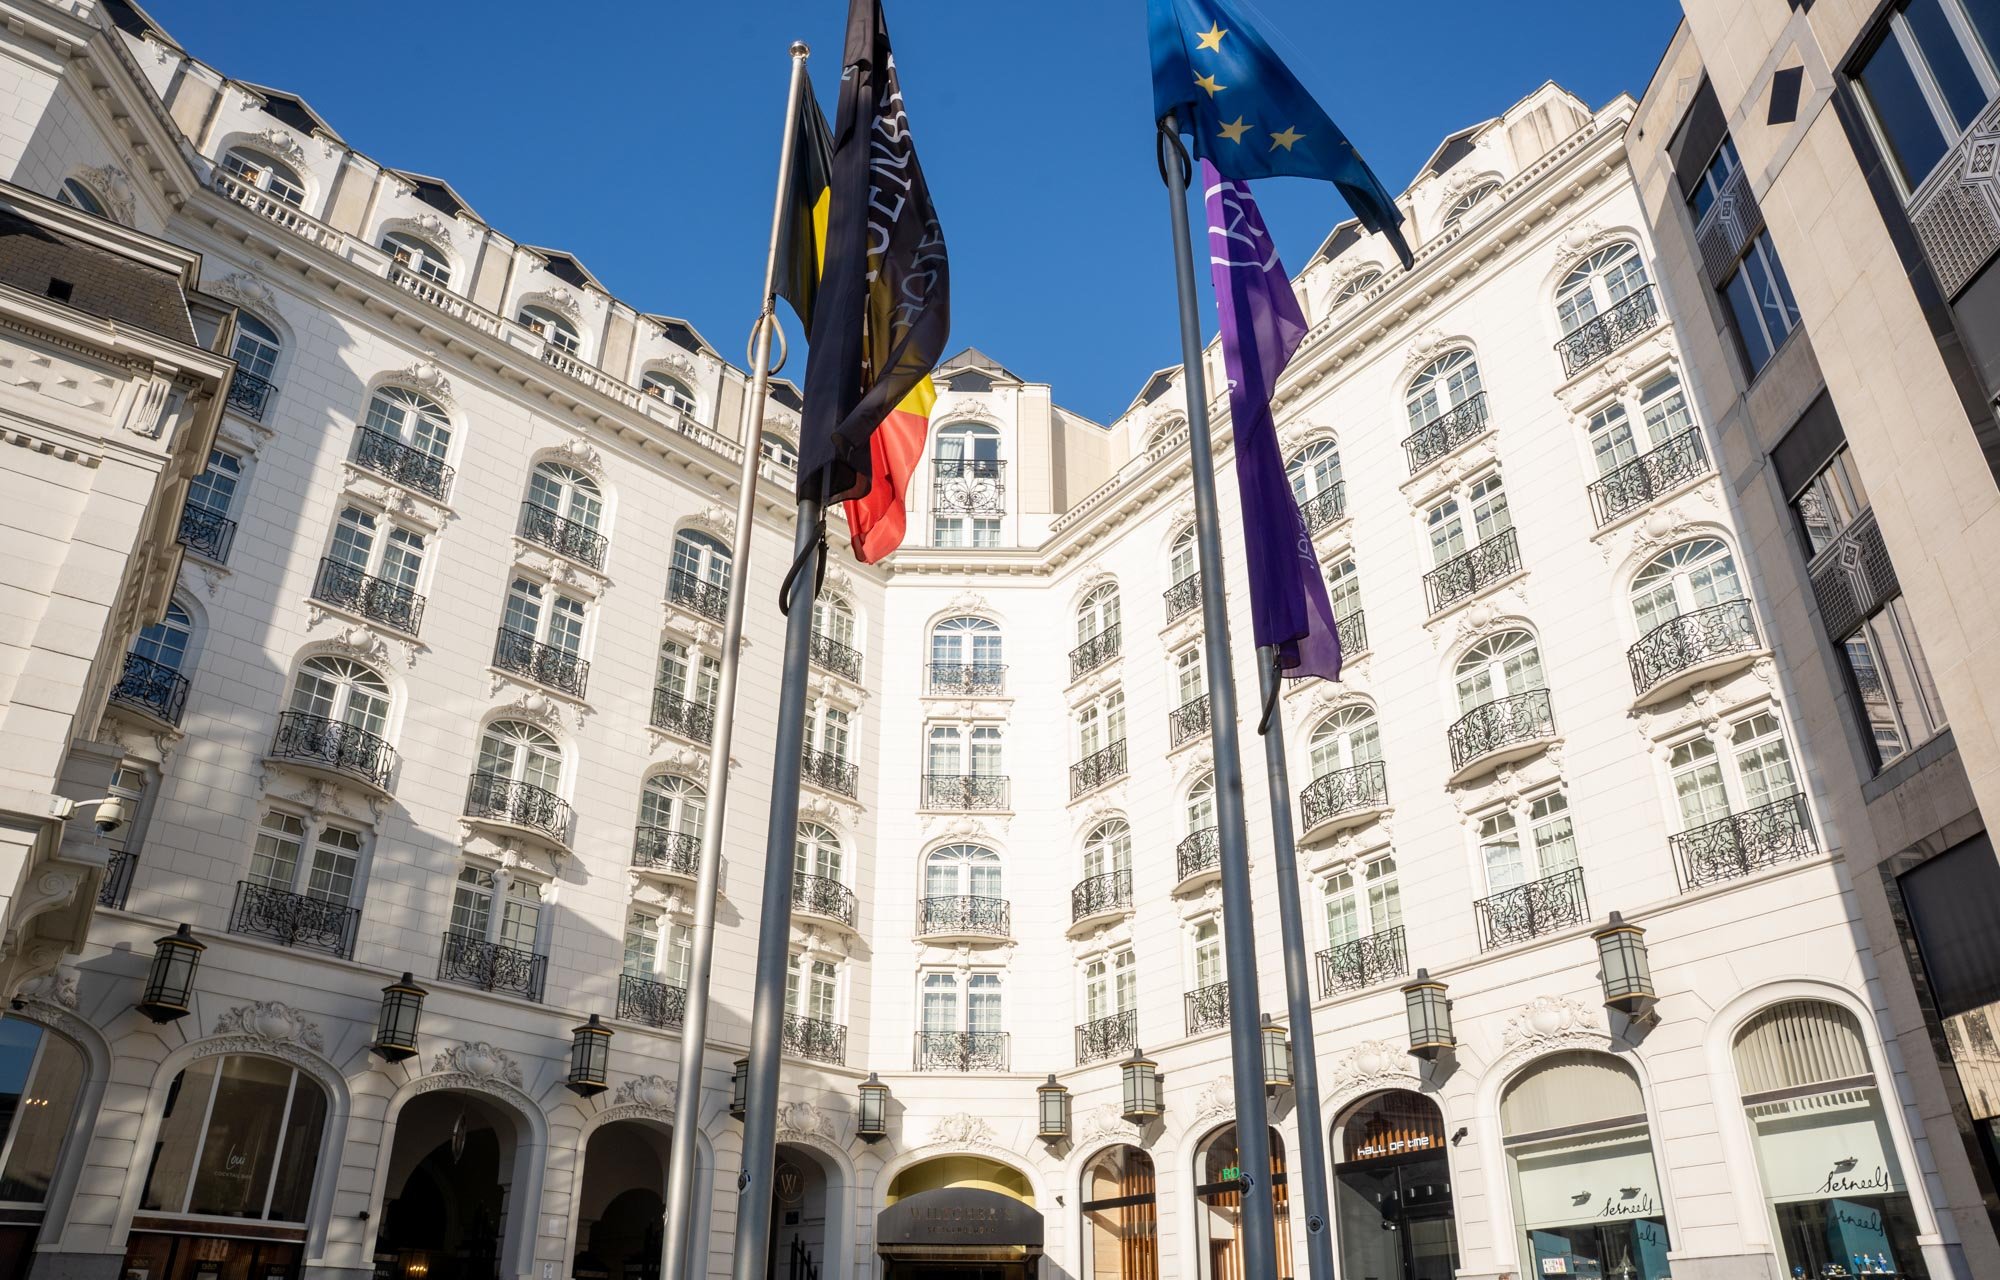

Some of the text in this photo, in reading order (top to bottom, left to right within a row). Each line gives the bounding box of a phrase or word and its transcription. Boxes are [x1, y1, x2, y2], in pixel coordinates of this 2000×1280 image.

[1222, 1167, 1240, 1180] RO
[1816, 1166, 1889, 1194] Serneels
[1597, 1193, 1653, 1217] Serneels
